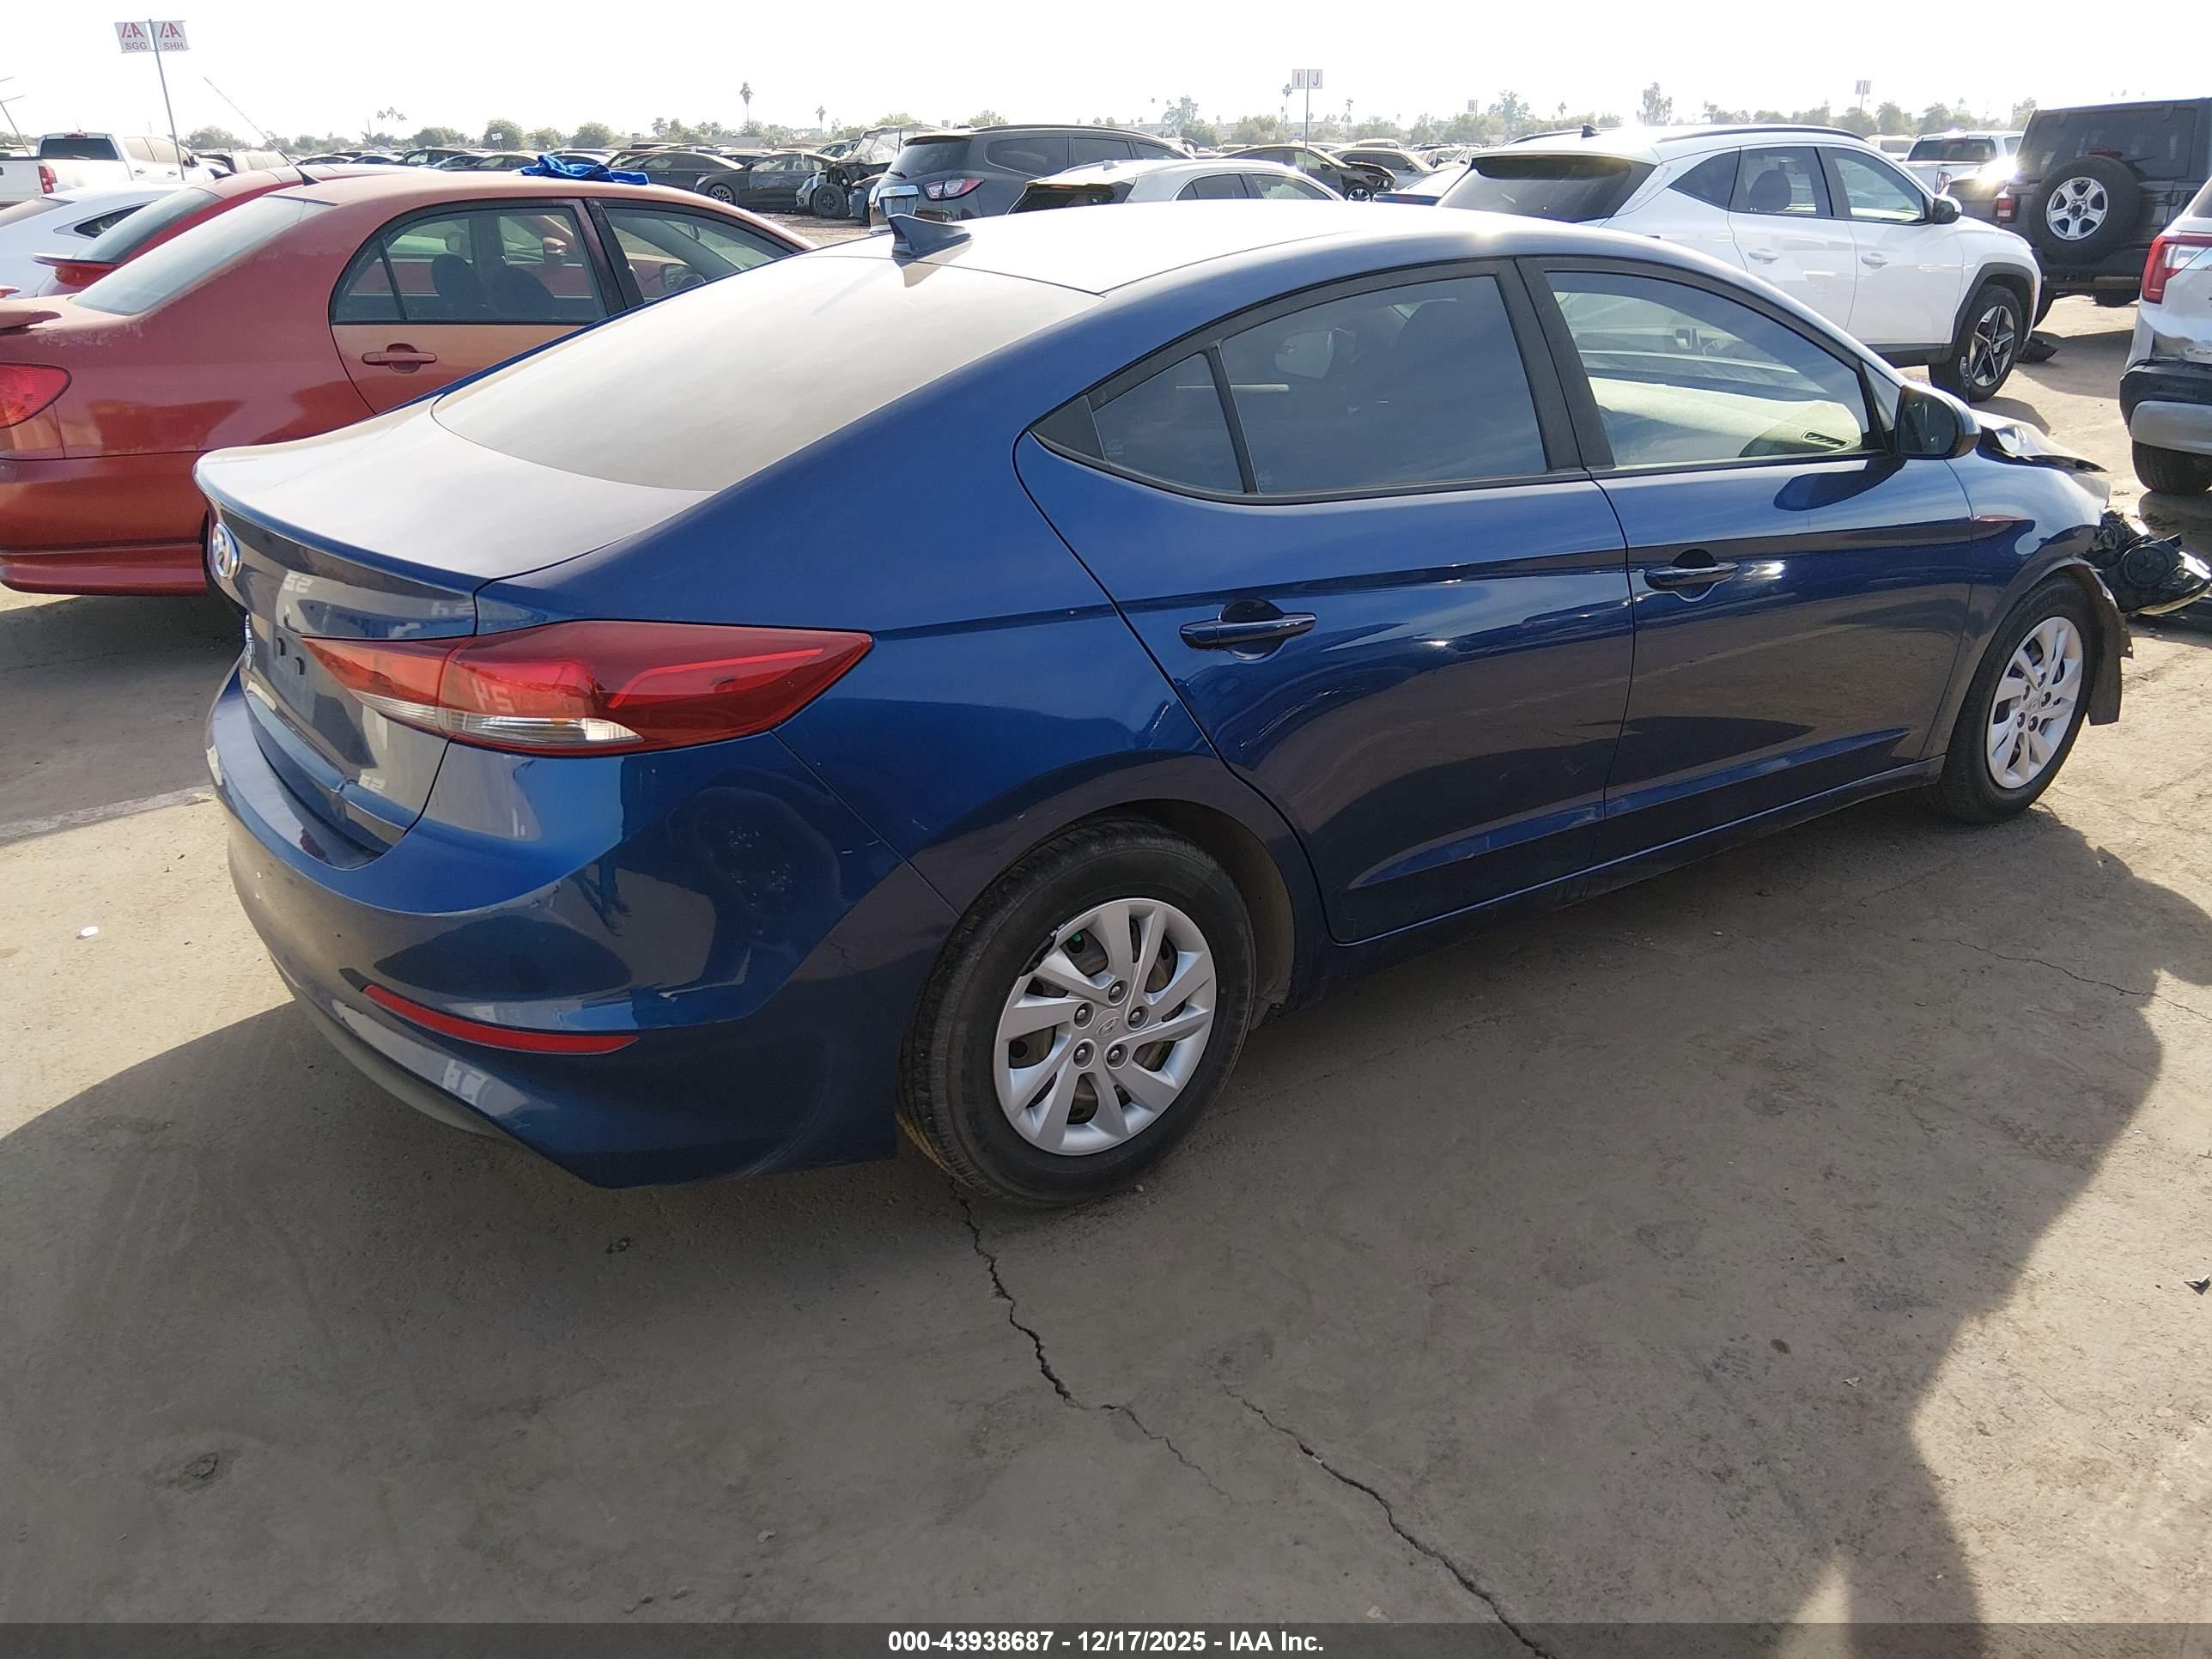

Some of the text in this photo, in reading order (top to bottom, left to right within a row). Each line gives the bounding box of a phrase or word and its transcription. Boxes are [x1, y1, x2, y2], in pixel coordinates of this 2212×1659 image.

[125, 41, 148, 50] SGG
[164, 41, 185, 50] SHH
[1313, 72, 1319, 87] J
